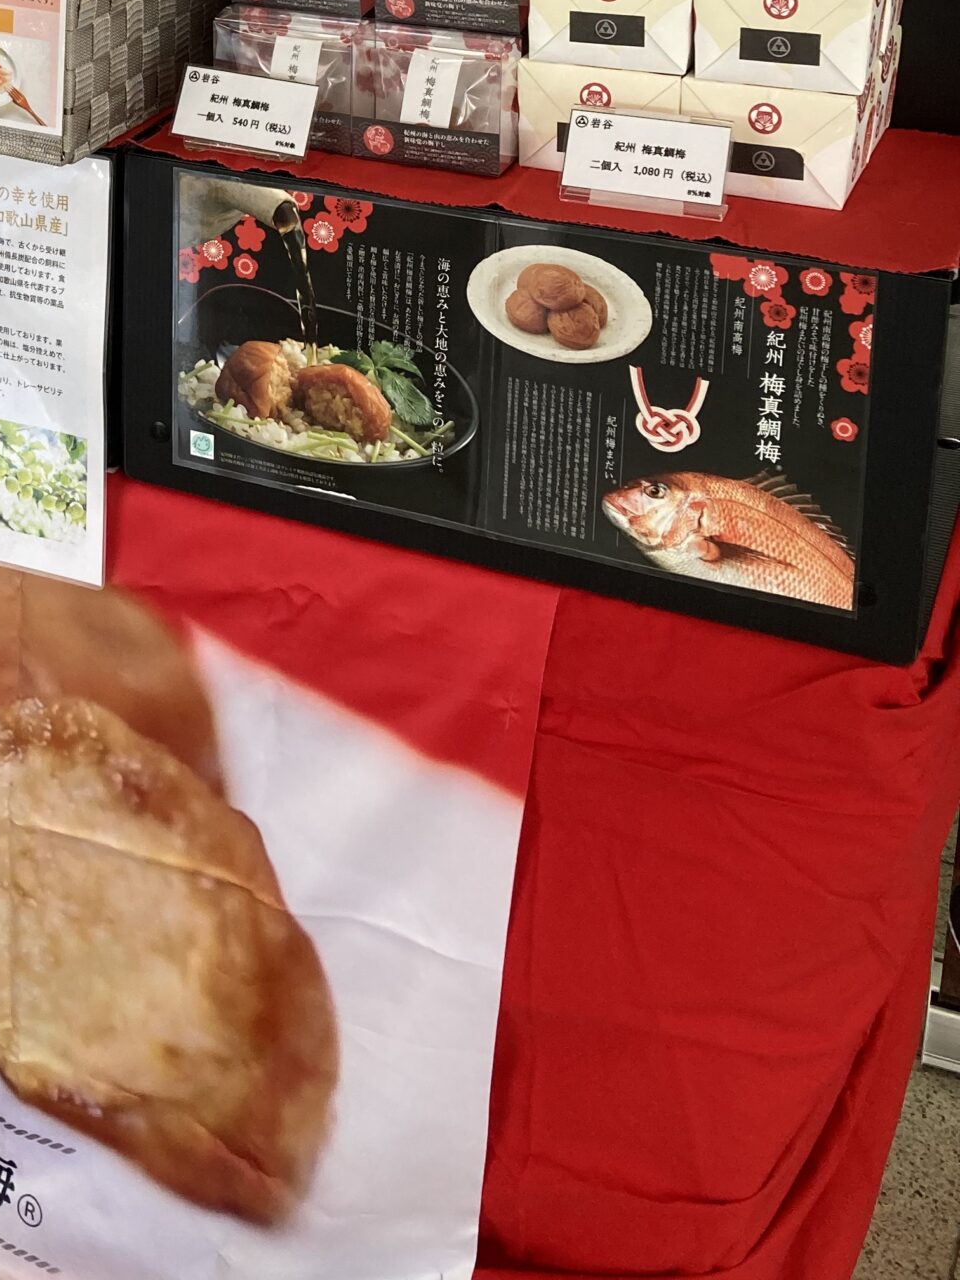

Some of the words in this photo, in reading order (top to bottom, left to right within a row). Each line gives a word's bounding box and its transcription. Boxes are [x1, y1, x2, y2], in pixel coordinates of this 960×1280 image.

[201, 73, 221, 84] 岩谷
[210, 93, 228, 105] 紀州
[590, 117, 614, 130] 岩谷
[614, 140, 637, 154] 紀州
[589, 158, 623, 173] 二個入
[764, 330, 787, 367] 紀州
[754, 372, 787, 464] 梅真鯛梅
